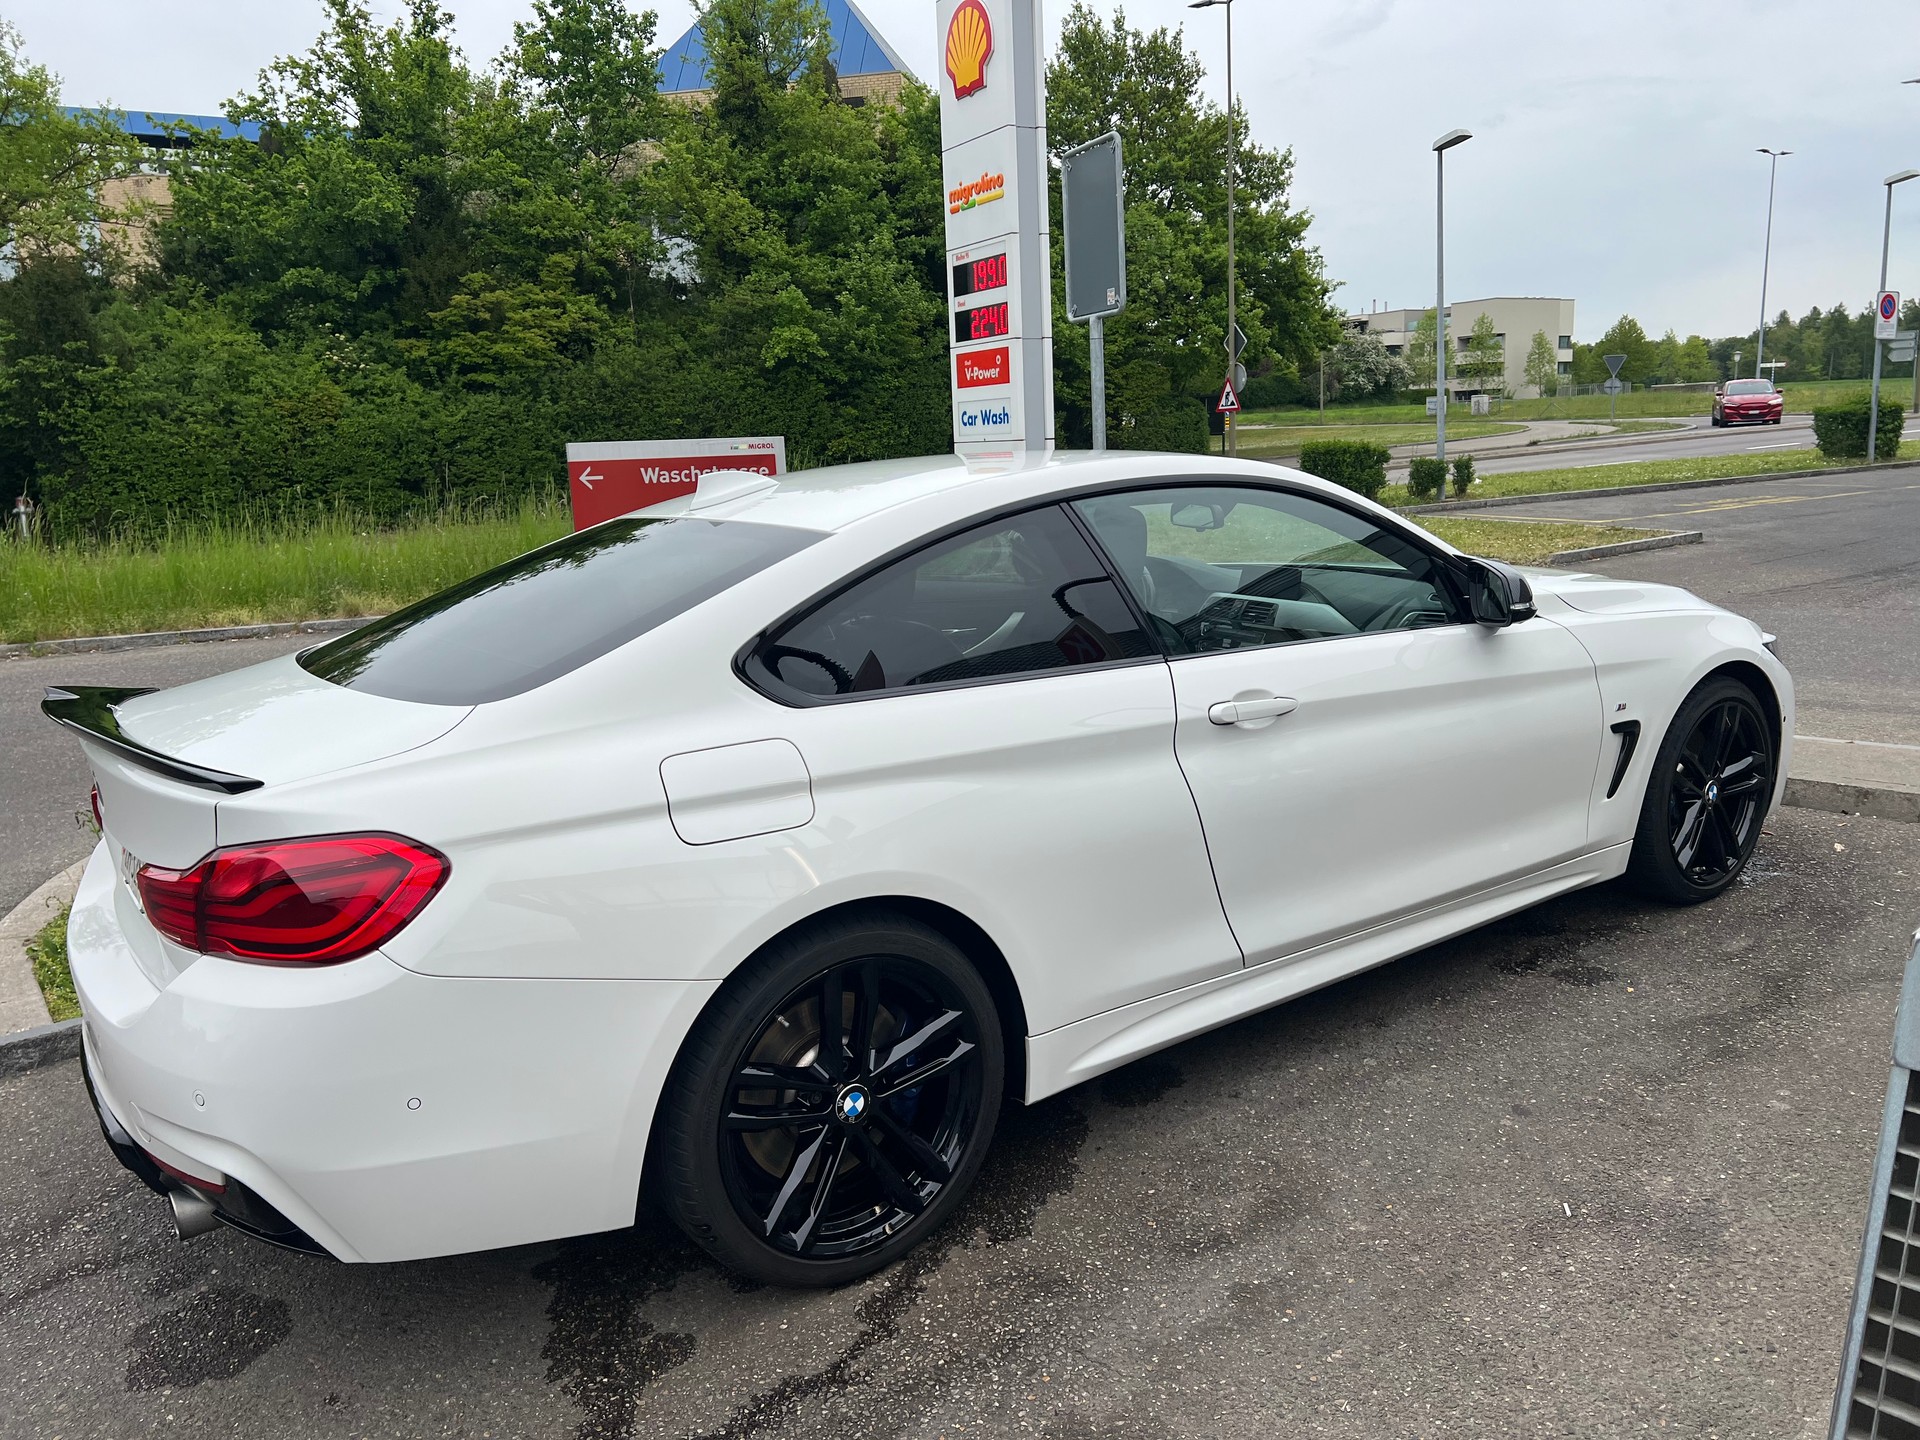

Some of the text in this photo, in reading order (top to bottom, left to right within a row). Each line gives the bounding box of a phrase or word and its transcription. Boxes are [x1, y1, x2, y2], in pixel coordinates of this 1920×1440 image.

[949, 172, 1004, 205] migrolino
[964, 367, 1000, 381] V-Power
[961, 406, 1010, 427] Car Wash
[640, 465, 770, 484] Wasche
